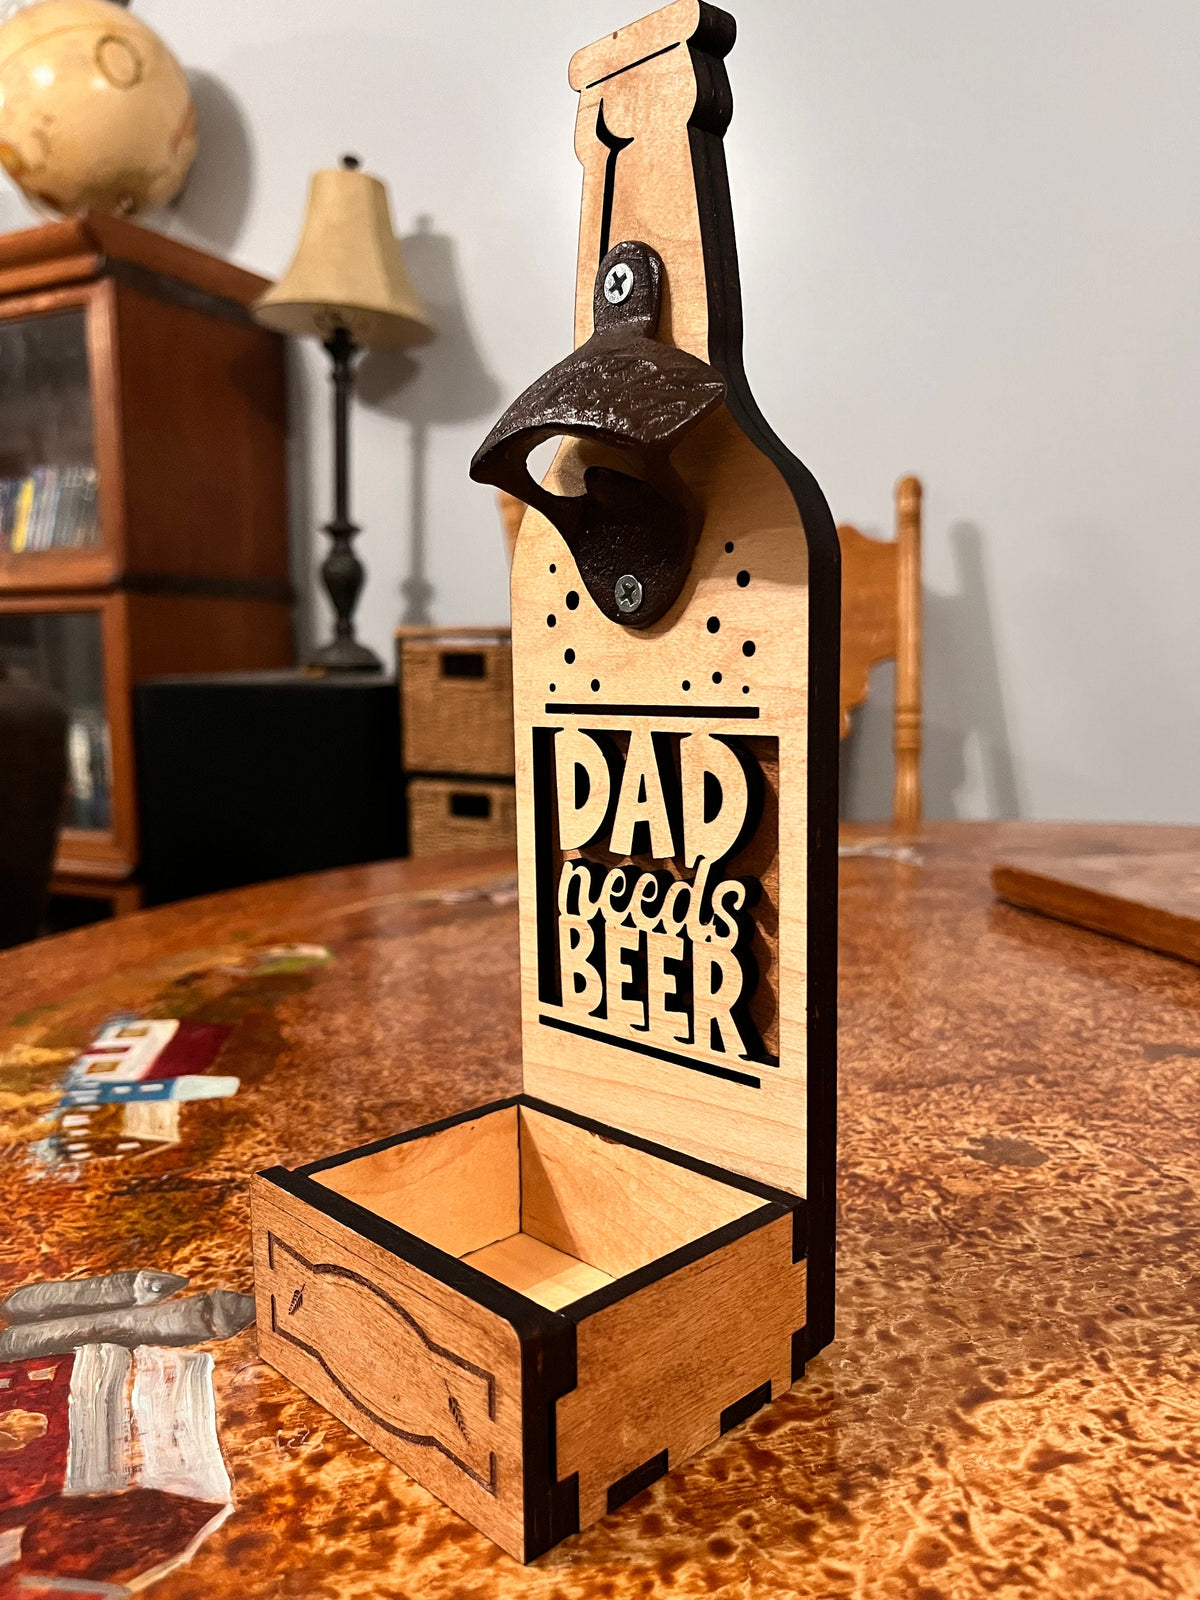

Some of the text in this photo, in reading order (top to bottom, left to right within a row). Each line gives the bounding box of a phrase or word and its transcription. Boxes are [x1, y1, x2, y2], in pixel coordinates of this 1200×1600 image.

[554, 728, 748, 869] DAD
[558, 857, 747, 943] needs
[558, 914, 748, 1058] BEER
